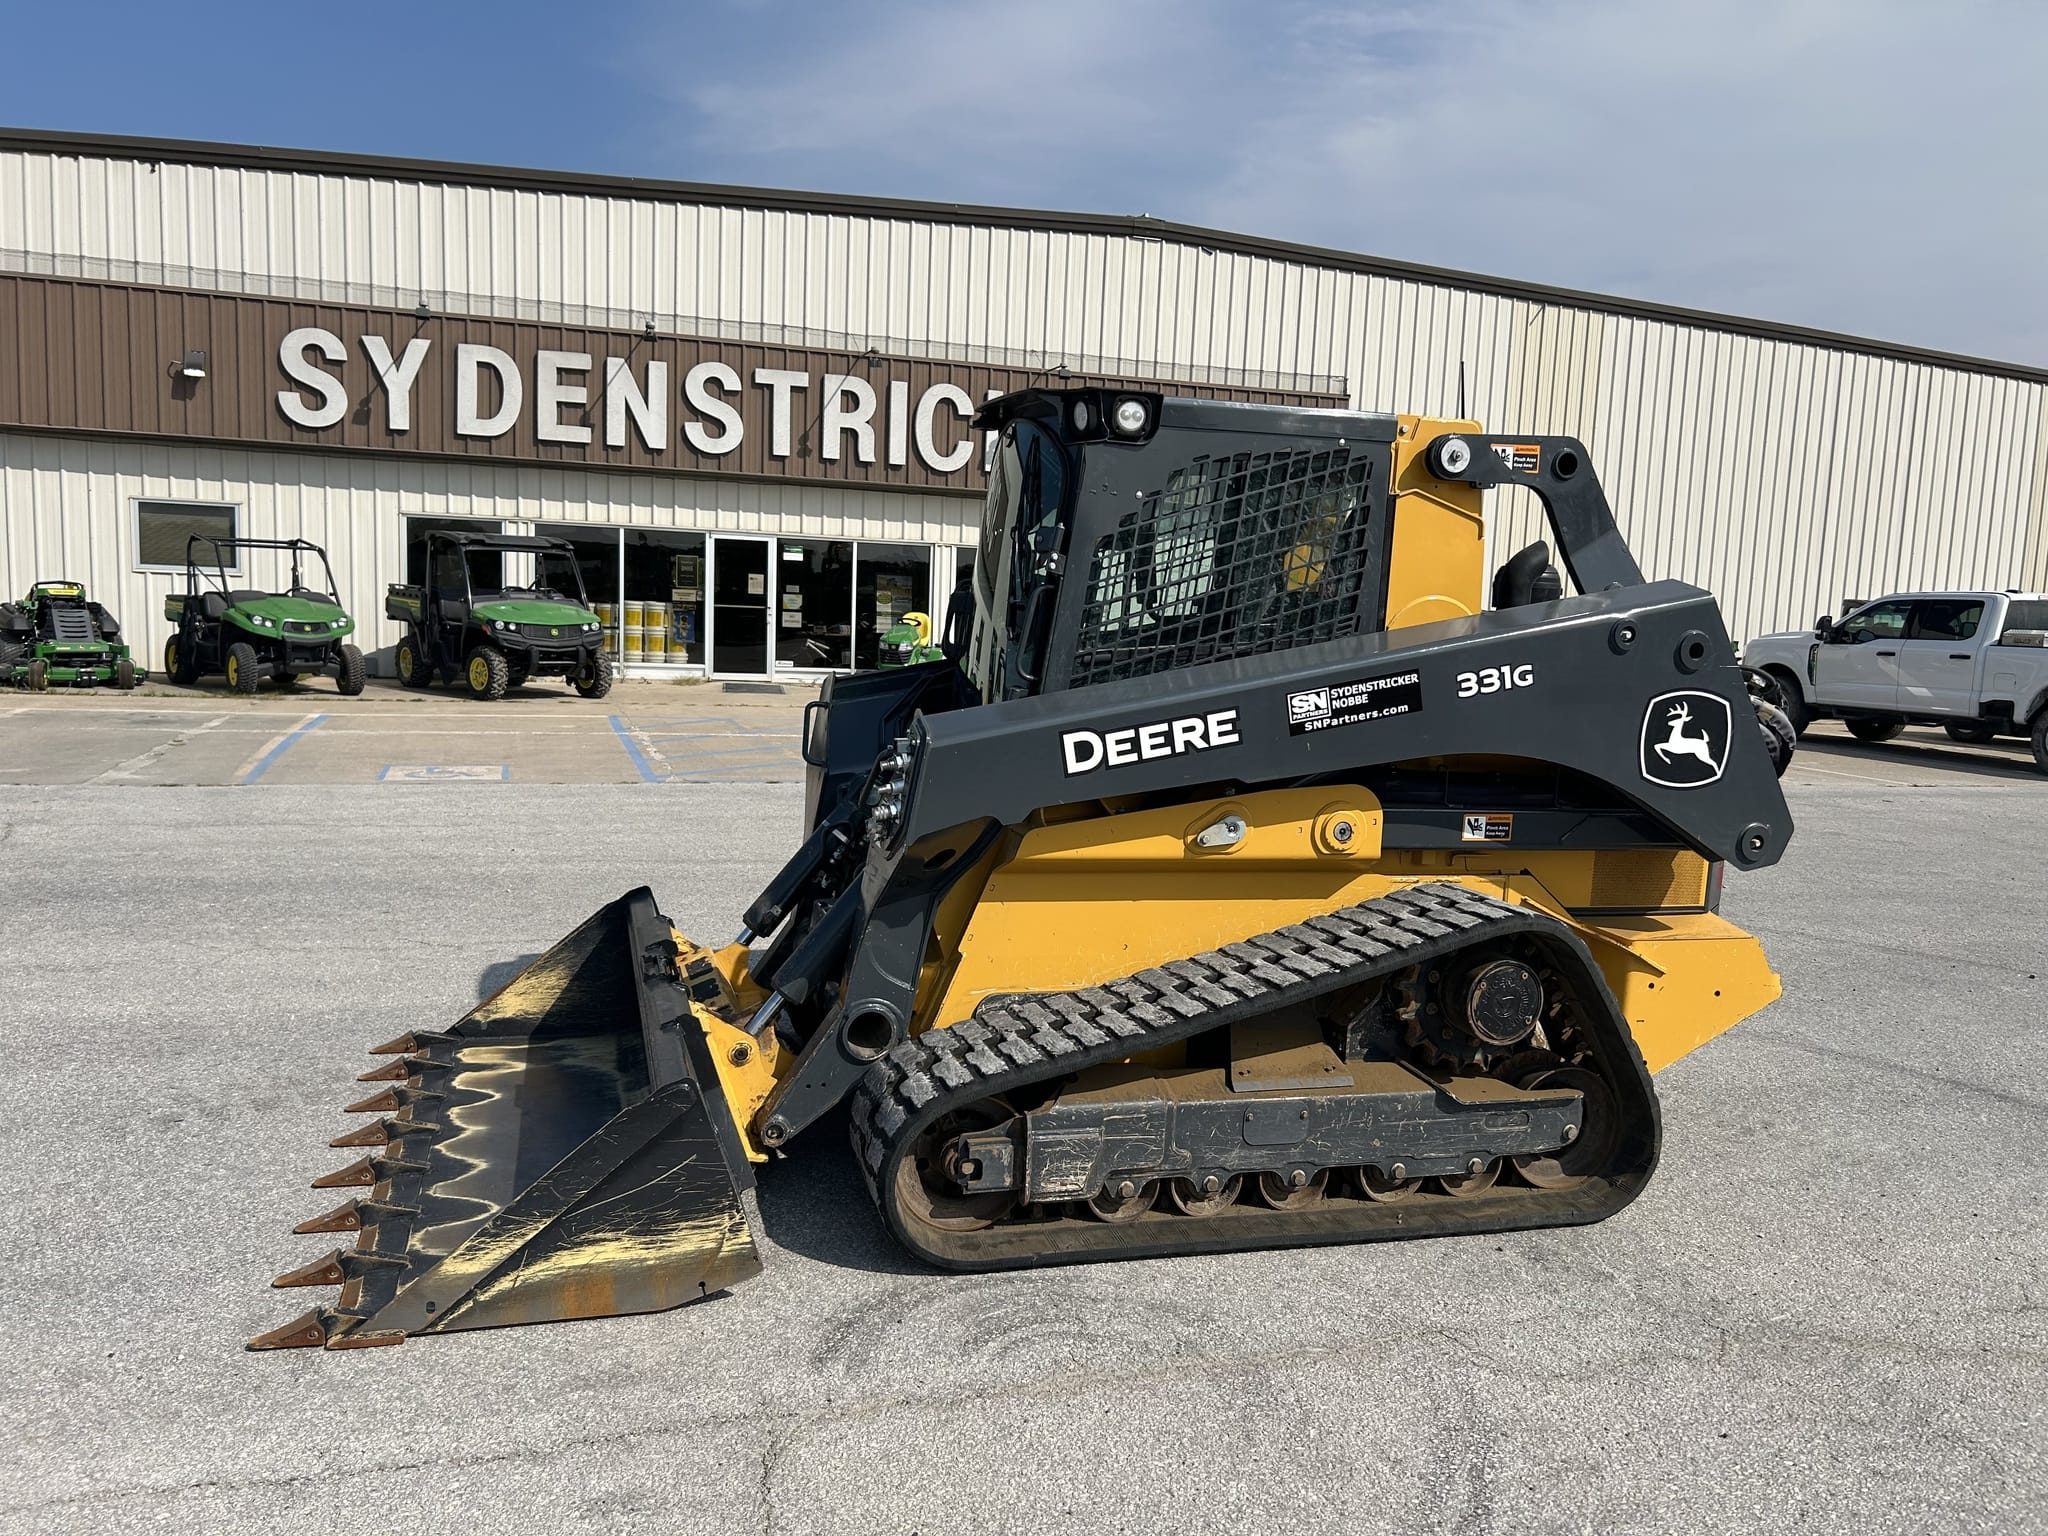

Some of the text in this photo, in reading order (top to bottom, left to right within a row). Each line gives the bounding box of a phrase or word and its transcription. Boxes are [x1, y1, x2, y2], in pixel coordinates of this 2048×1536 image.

[1330, 673, 1420, 699] SYDENSTRICKER
[1456, 664, 1534, 698] 331G
[1292, 708, 1329, 720] PARTNERS
[1331, 693, 1369, 710] NOBBE
[1304, 704, 1409, 731] SNPartners.com
[1062, 710, 1240, 775] DEERE
